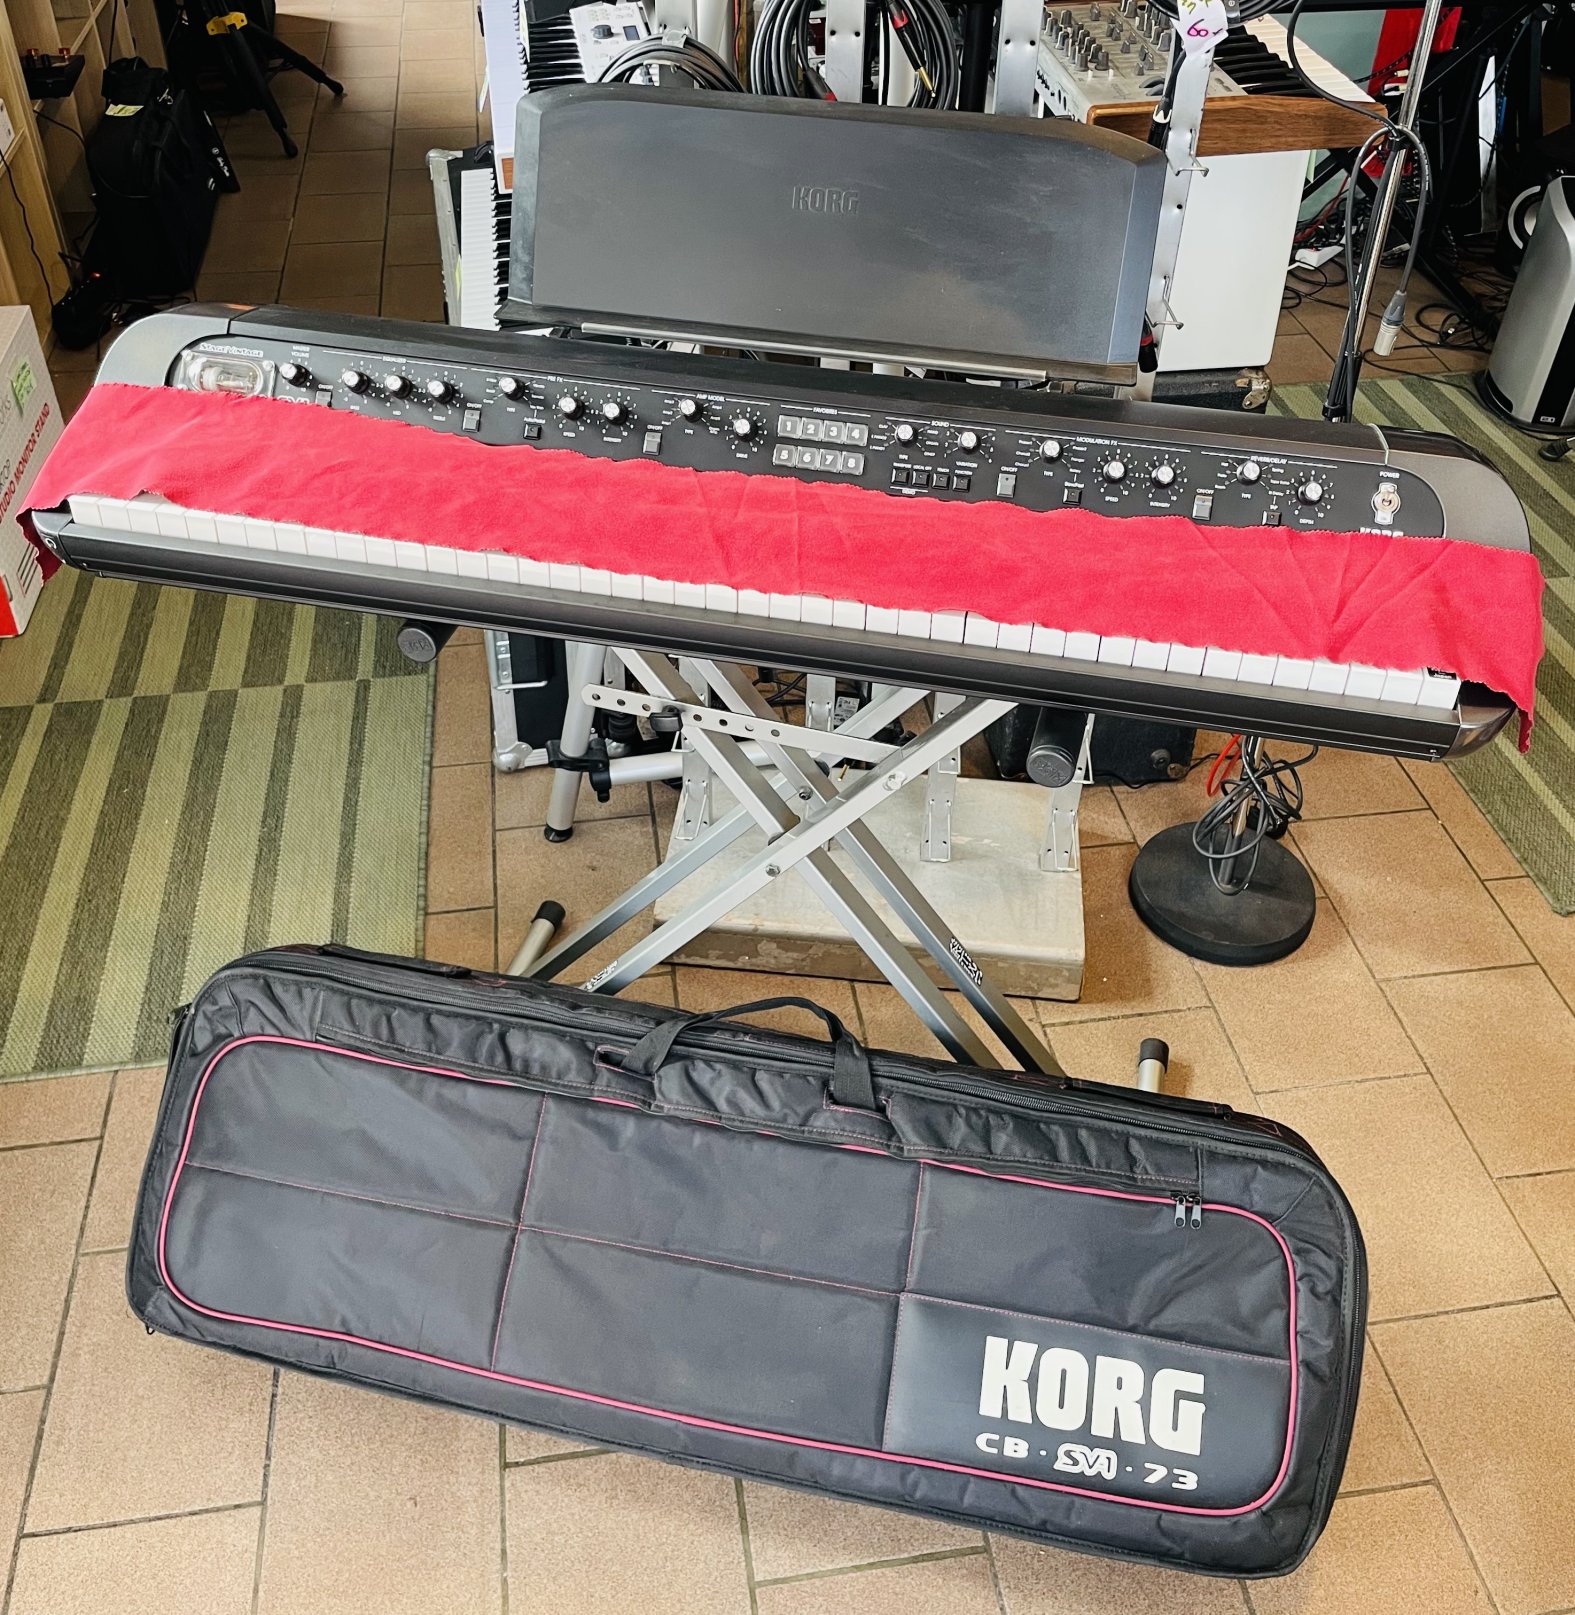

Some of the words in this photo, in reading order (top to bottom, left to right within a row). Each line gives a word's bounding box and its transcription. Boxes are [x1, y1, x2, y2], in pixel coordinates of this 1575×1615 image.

[792, 185, 859, 214] KORG
[786, 422, 792, 431] 1
[806, 424, 815, 434] 2
[830, 426, 838, 436] 3
[851, 428, 860, 439] 4
[14, 433, 37, 485] MONITOR
[35, 402, 50, 438] STAND
[1076, 436, 1110, 446] MODULATION
[780, 450, 788, 460] 5
[802, 452, 812, 462] 6
[824, 454, 834, 464] 7
[1250, 456, 1288, 464] REVERB/DELAY
[847, 458, 856, 468] 8
[979, 1335, 1206, 1456] KORG
[1143, 1462, 1199, 1491] 73
